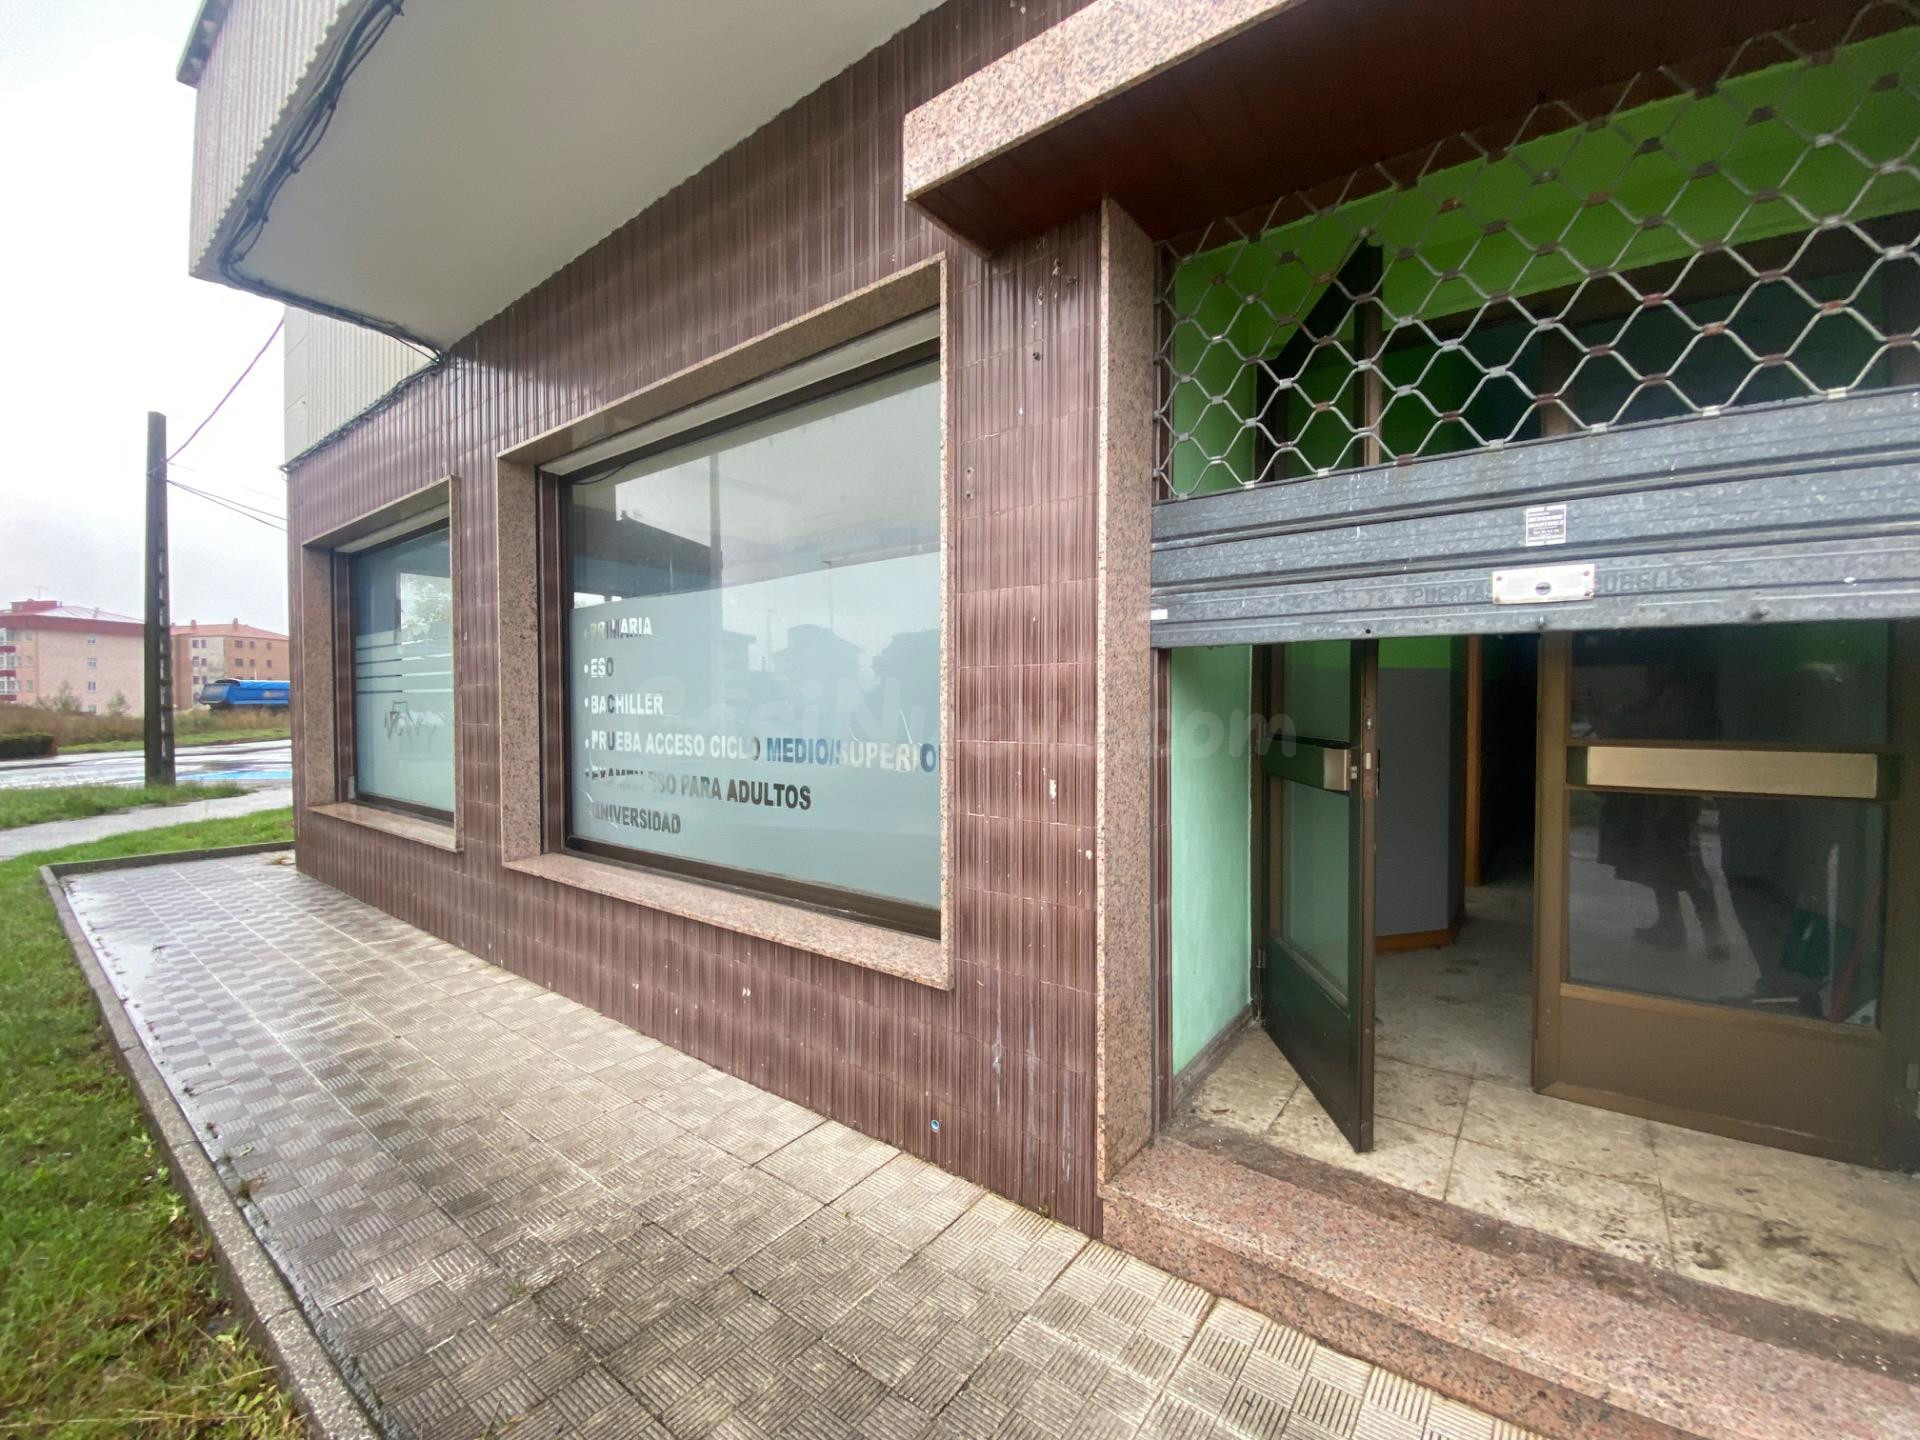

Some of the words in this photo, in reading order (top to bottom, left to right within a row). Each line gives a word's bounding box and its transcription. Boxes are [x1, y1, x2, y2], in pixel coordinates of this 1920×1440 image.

[590, 657, 614, 677] ESO
[591, 693, 664, 715] BACHILLER
[591, 730, 642, 753] PRUEBA
[645, 732, 705, 757] ACCESO
[766, 737, 941, 773] MEDIO/SUPERIO
[680, 775, 722, 801] PARA
[726, 778, 812, 811] ADULTOS
